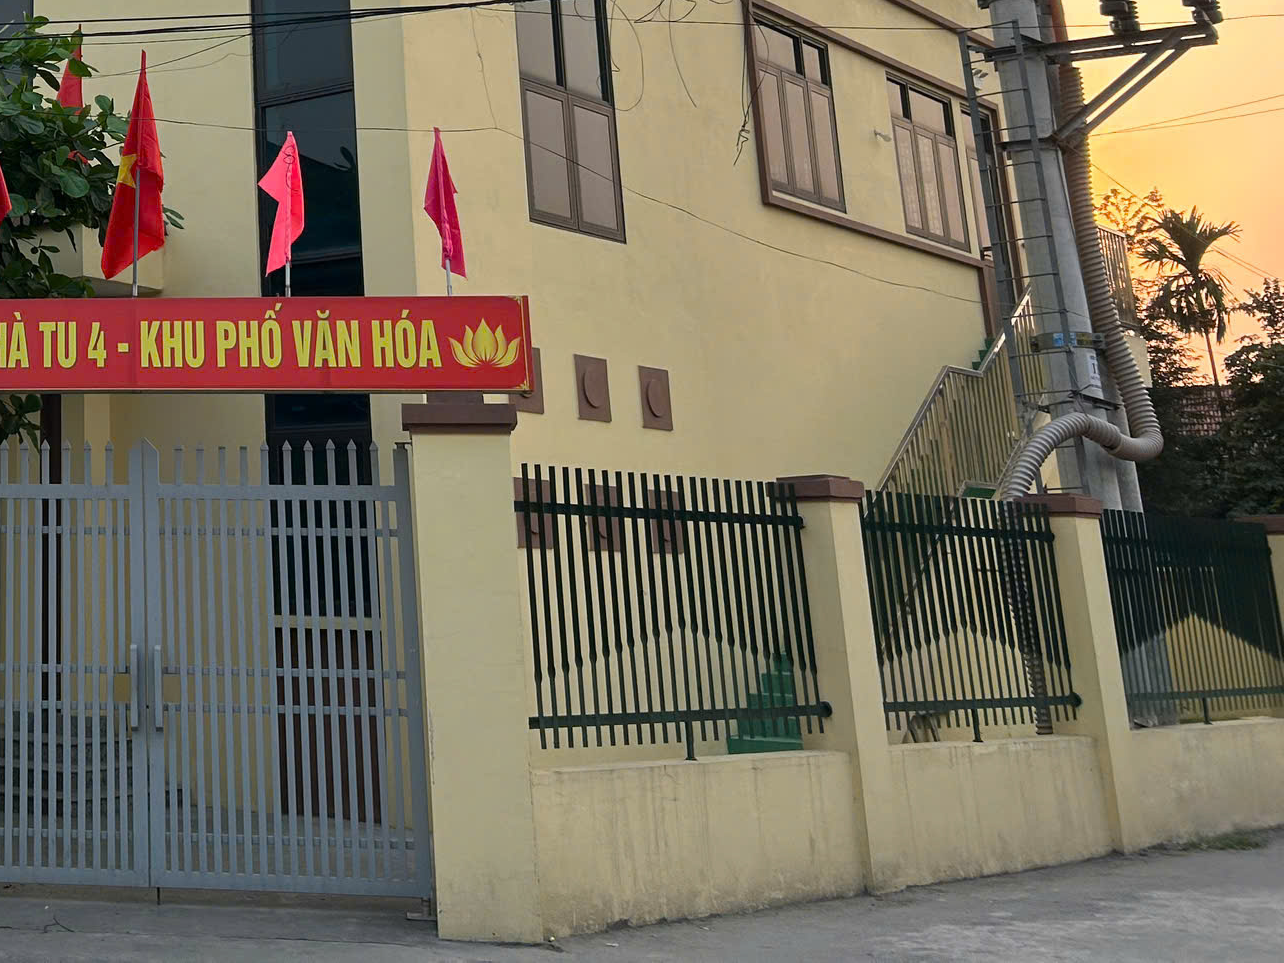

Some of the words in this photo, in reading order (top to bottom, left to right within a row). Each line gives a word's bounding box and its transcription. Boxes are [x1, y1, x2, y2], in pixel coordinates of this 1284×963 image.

[38, 320, 77, 369] TU
[87, 321, 108, 368] 4
[117, 341, 130, 354] -
[139, 320, 206, 369] KHU
[215, 302, 283, 369] PHỐ
[292, 309, 362, 368] VĂN
[371, 308, 444, 368] HÓA
